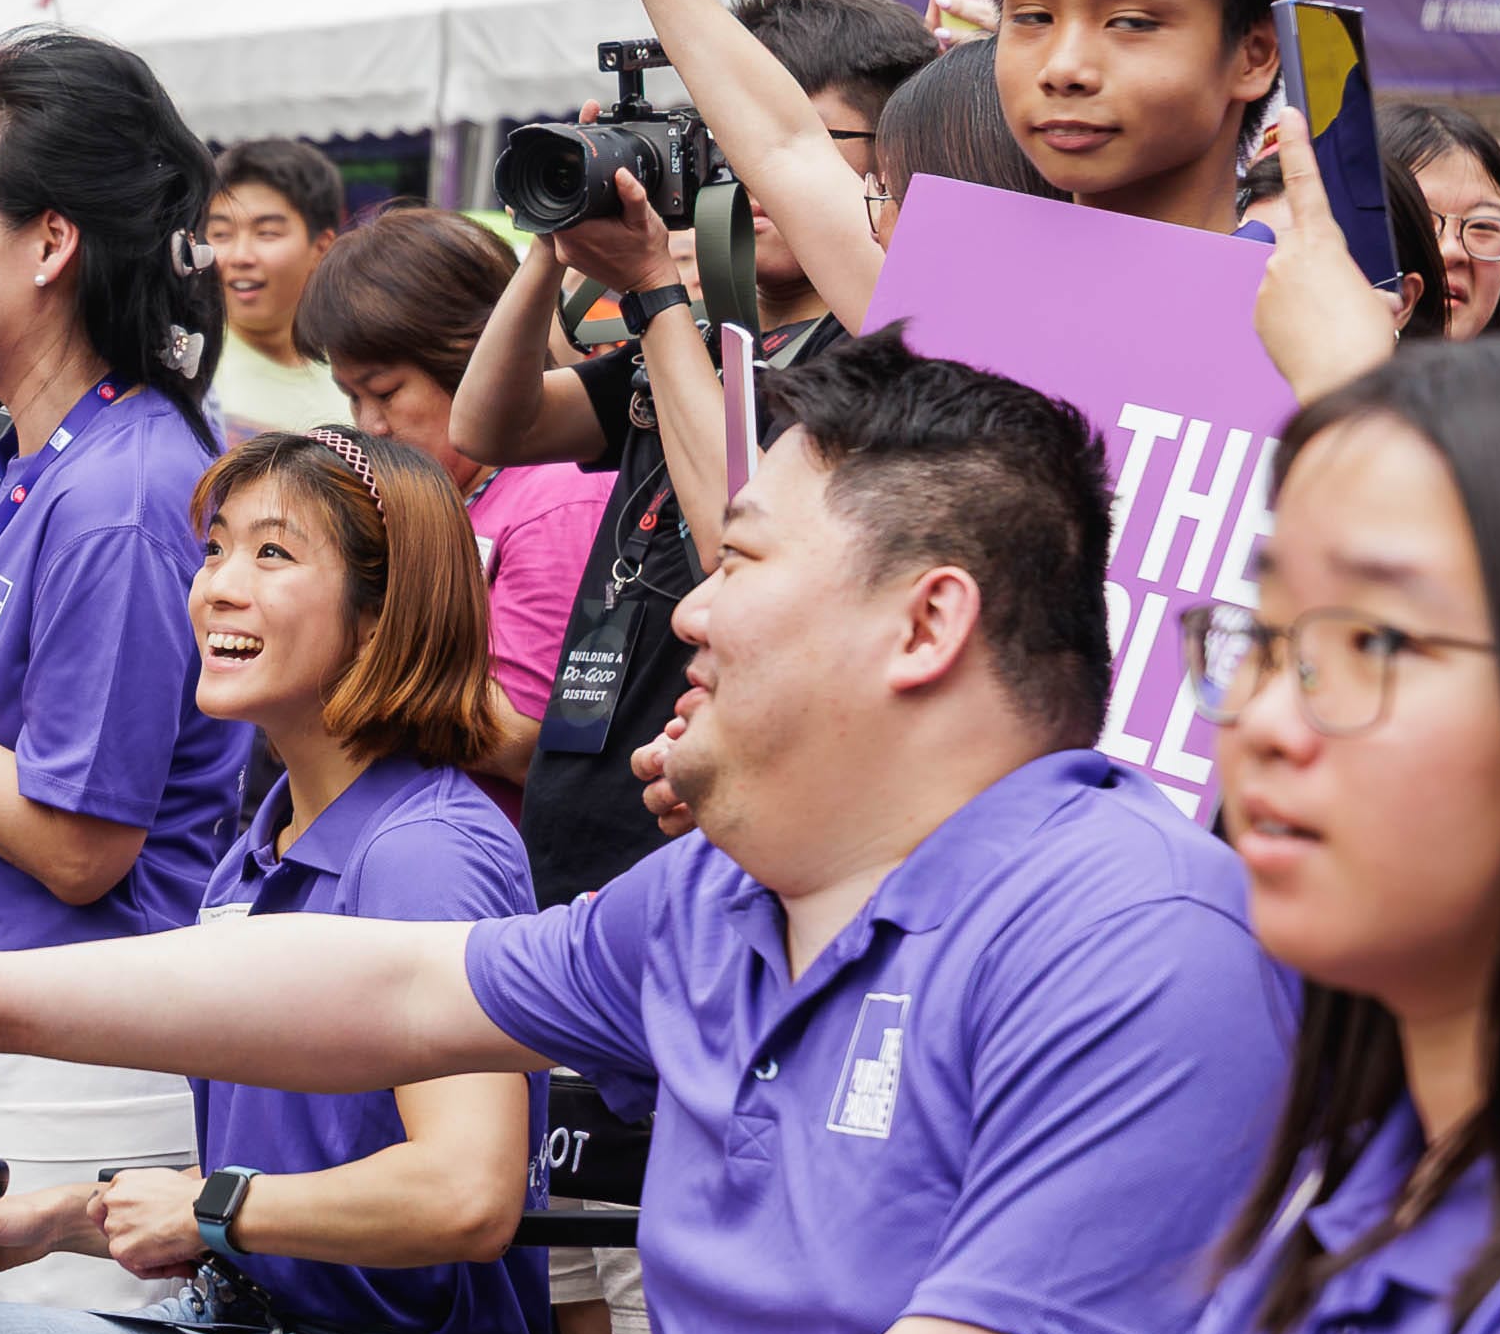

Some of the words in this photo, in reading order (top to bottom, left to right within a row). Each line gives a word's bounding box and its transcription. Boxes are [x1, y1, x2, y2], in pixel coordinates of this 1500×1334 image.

[1108, 402, 1281, 610] THE
[568, 650, 614, 663] BUILDING
[615, 652, 623, 664] A
[562, 688, 608, 702] DISTRICT
